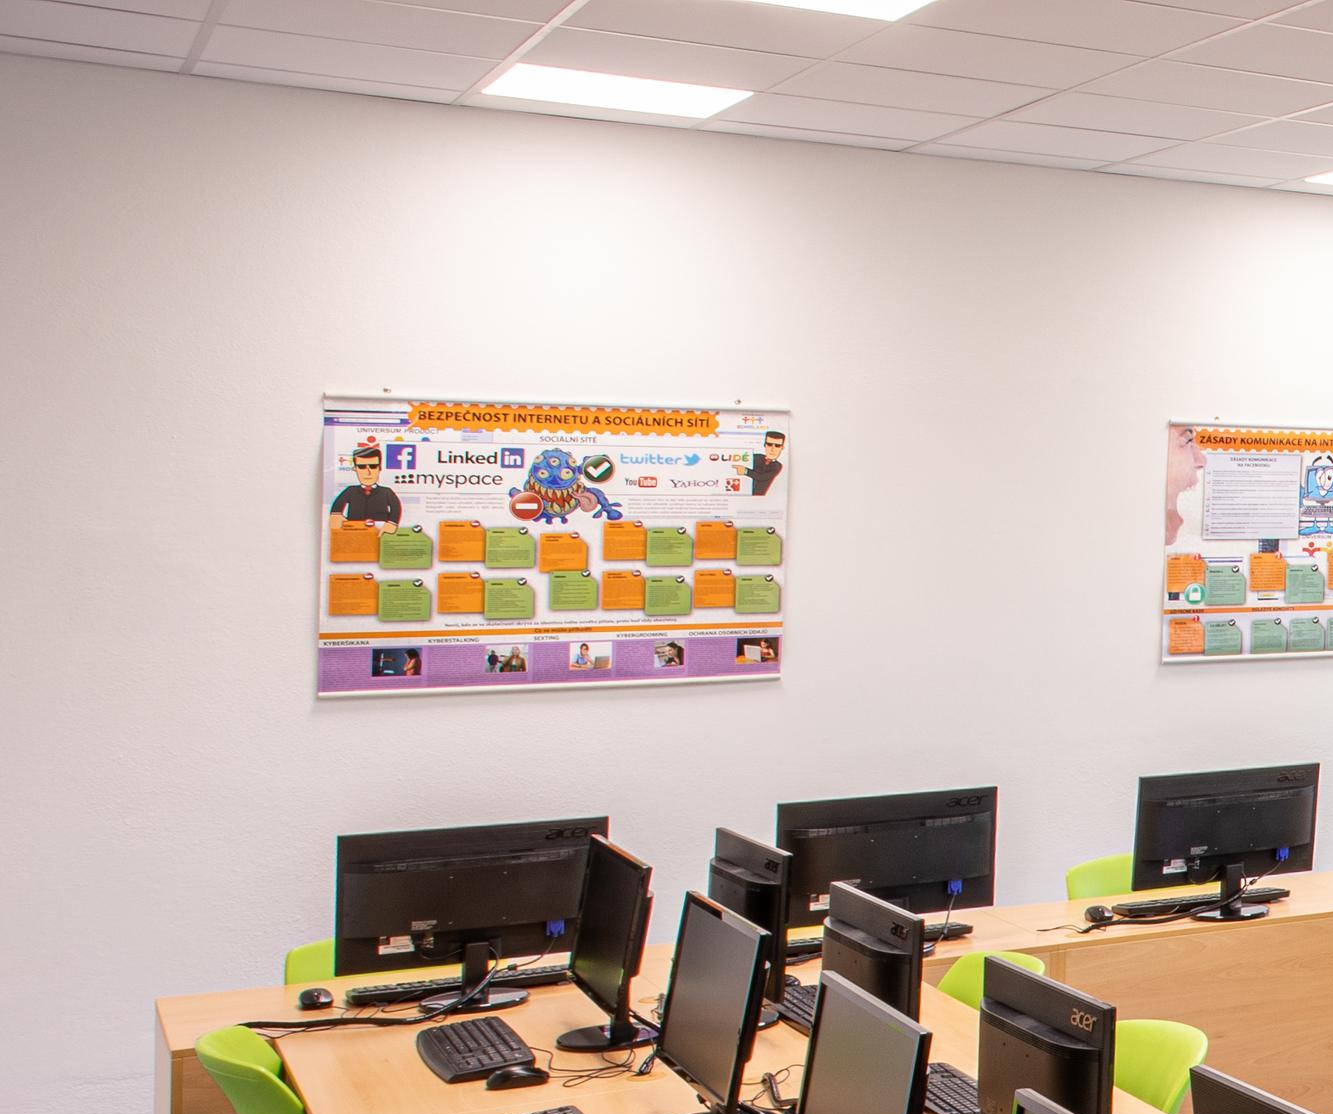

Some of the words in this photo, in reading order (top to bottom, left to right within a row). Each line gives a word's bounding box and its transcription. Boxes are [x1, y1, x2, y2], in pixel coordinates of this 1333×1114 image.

[418, 410, 510, 422] BEZPEČNOST
[513, 413, 589, 425] INTERNETU
[593, 416, 601, 425] A
[605, 415, 684, 427] SOCIÁLNÍCH
[687, 416, 710, 428] SÍTÍ
[1199, 434, 1238, 444] ZÁSADY
[1240, 437, 1302, 446] KOMUNIKACE
[1304, 438, 1317, 446] NA
[620, 453, 684, 465] twitter
[416, 473, 503, 488] myspace
[1071, 1007, 1098, 1033] acer
